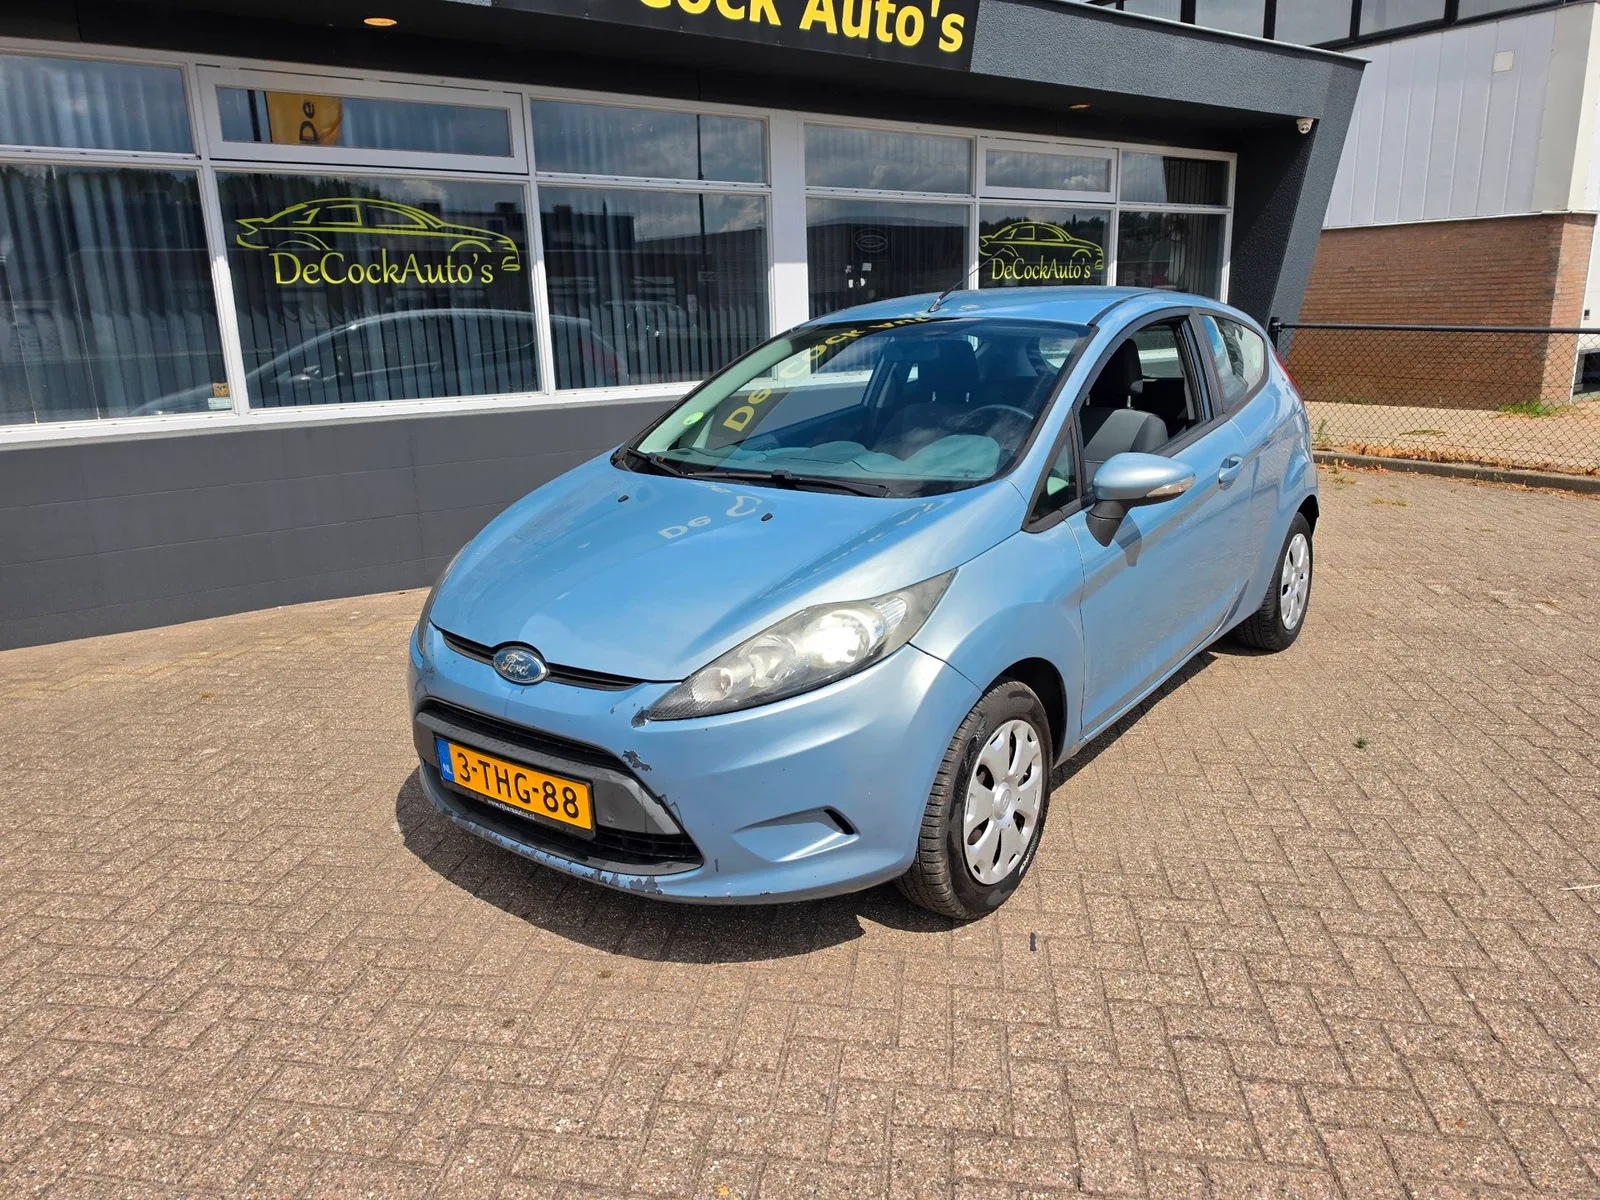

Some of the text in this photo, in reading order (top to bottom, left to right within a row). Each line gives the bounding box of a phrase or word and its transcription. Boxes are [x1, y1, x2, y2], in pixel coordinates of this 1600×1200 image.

[799, 0, 966, 52] Auto's
[501, 653, 531, 676] Ford
[442, 762, 453, 775] NL
[457, 752, 579, 819] 3-THG-88
